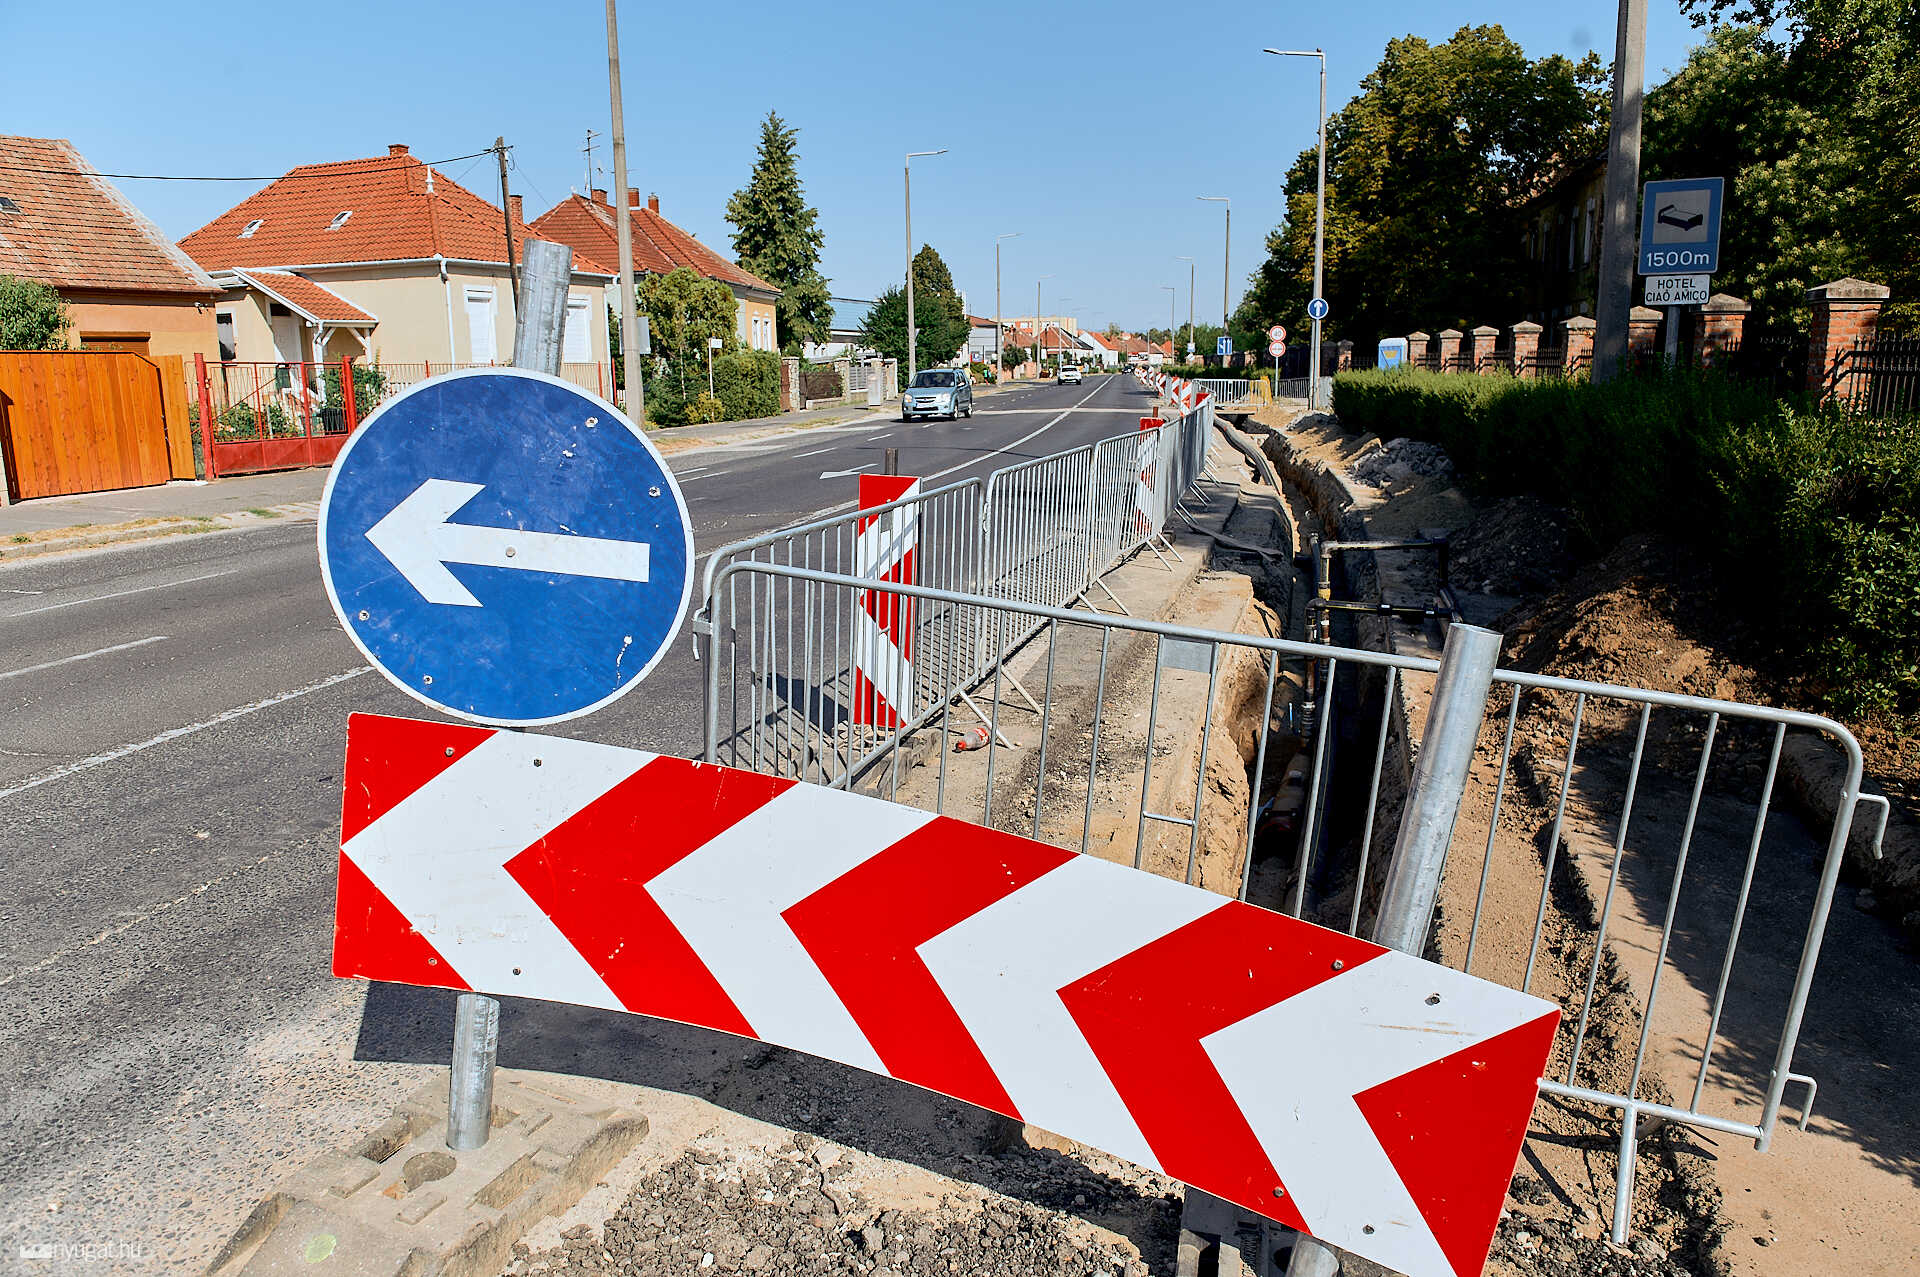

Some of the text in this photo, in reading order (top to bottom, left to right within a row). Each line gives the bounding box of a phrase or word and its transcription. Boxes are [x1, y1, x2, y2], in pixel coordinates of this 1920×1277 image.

[1646, 251, 1709, 267] 1500m
[1657, 278, 1696, 290] HOTEL
[1673, 290, 1707, 301] AMICO
